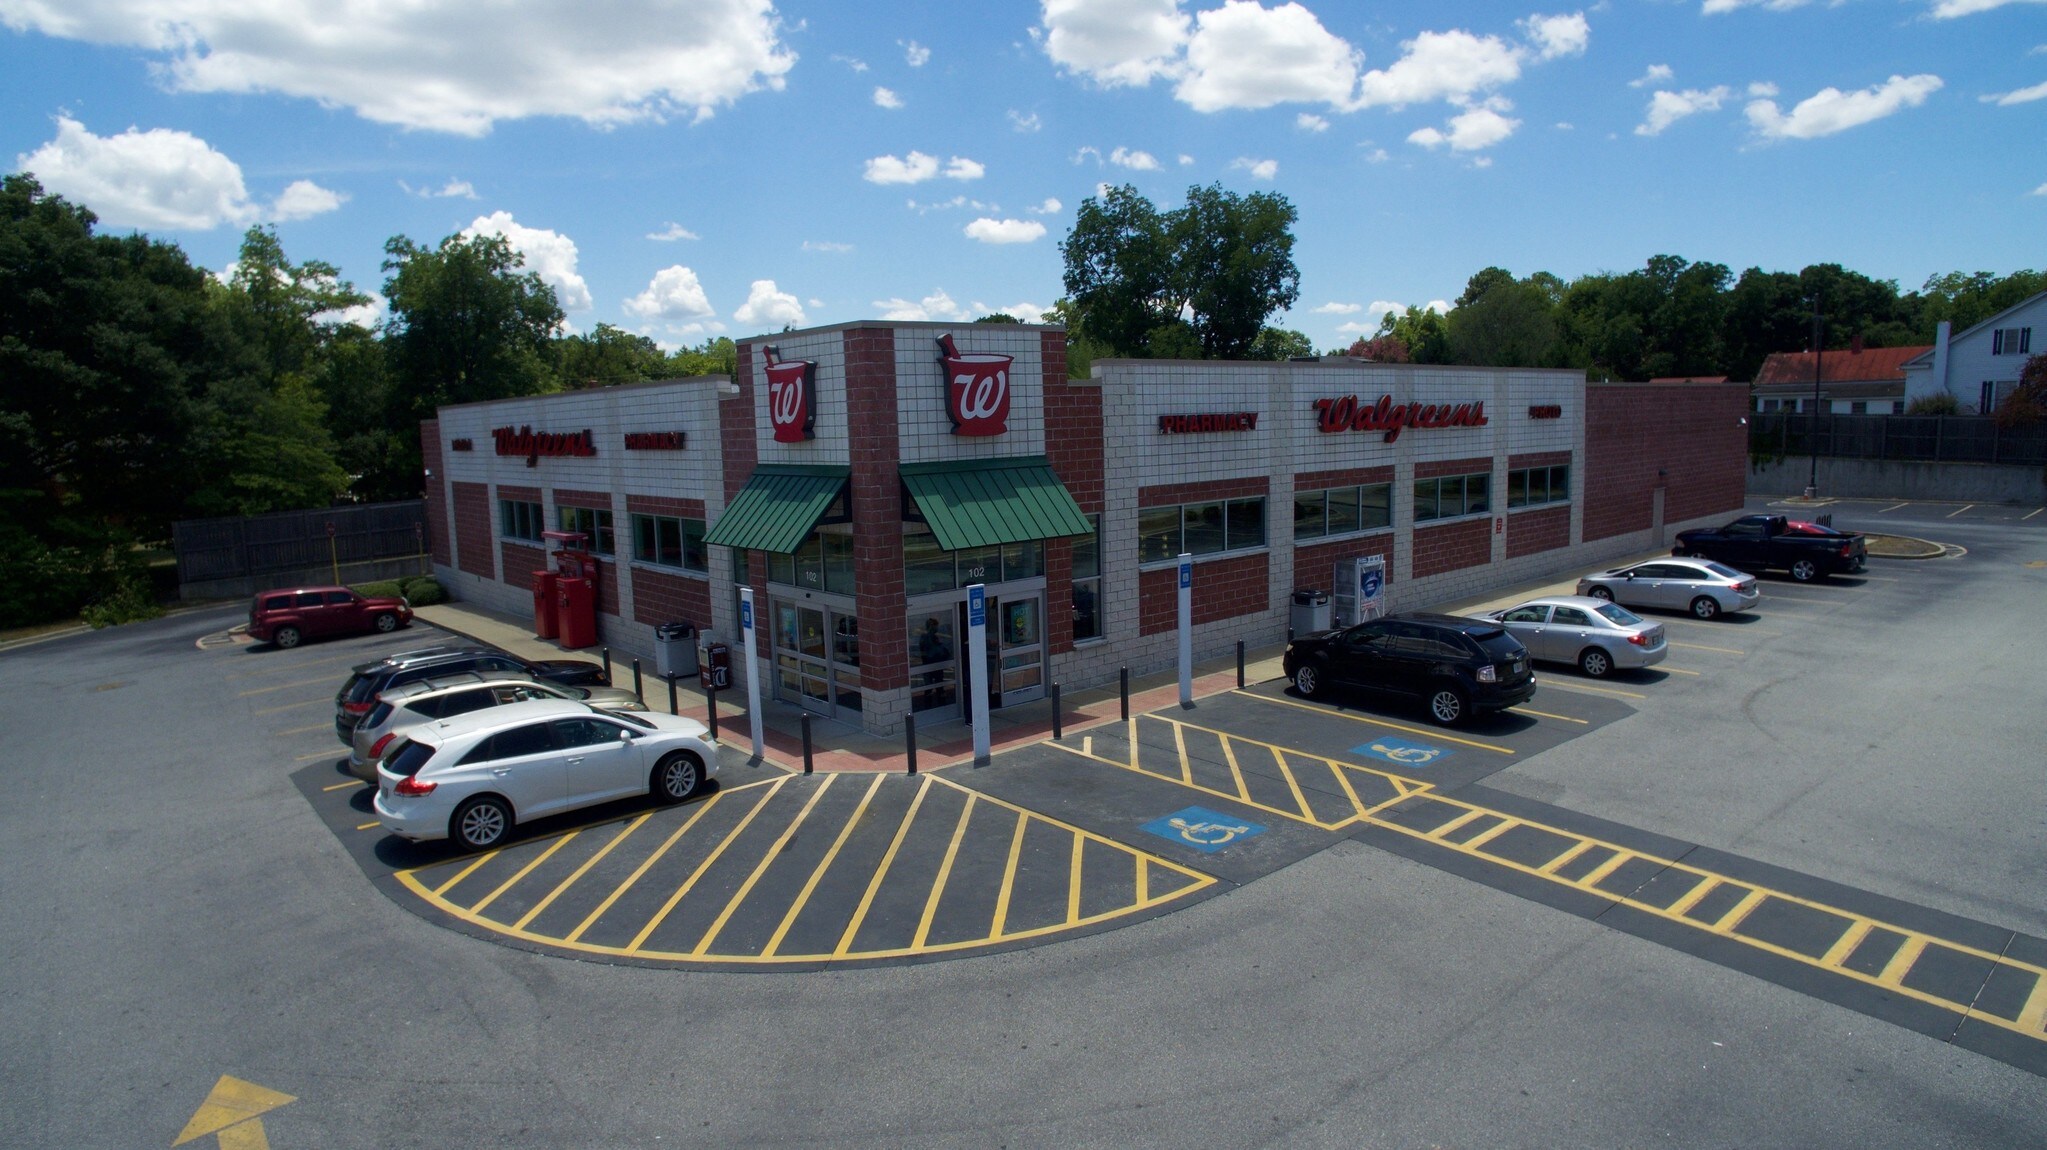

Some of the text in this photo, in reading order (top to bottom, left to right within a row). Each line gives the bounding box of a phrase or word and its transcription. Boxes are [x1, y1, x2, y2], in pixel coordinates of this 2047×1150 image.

[770, 376, 803, 424] W
[953, 370, 1006, 420] W
[1161, 412, 1259, 434] PHARMACY
[1314, 393, 1489, 443] Walgreens
[492, 425, 596, 468] Walgreens
[624, 432, 685, 450] PHARMACY
[805, 570, 817, 582] 102
[968, 567, 985, 578] 102
